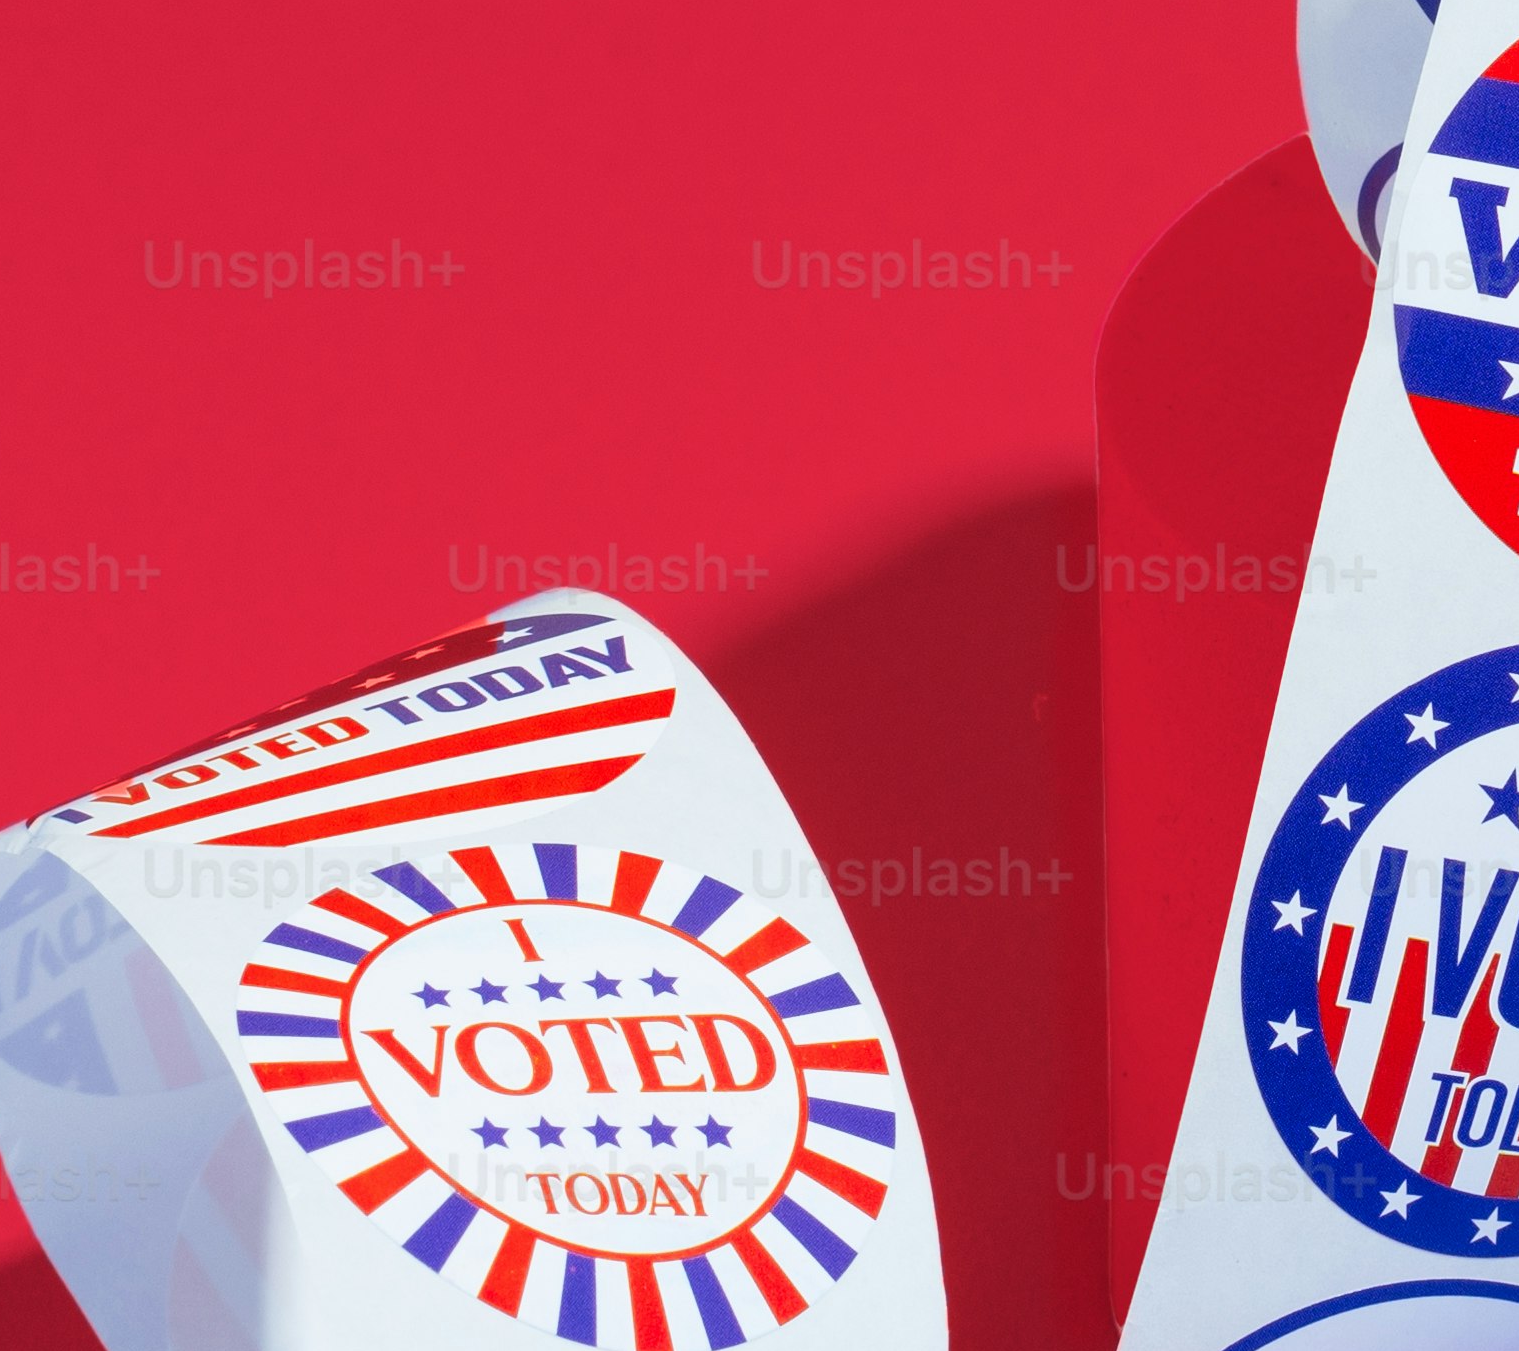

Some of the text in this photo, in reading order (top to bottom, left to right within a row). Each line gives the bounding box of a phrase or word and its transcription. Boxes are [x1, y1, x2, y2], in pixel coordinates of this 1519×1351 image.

[92, 716, 369, 805] VOTED
[364, 637, 634, 725] TODAY
[502, 919, 544, 962] I
[1347, 846, 1407, 1003] I
[360, 1014, 777, 1097] VOTED
[527, 1174, 709, 1215] TODAY
